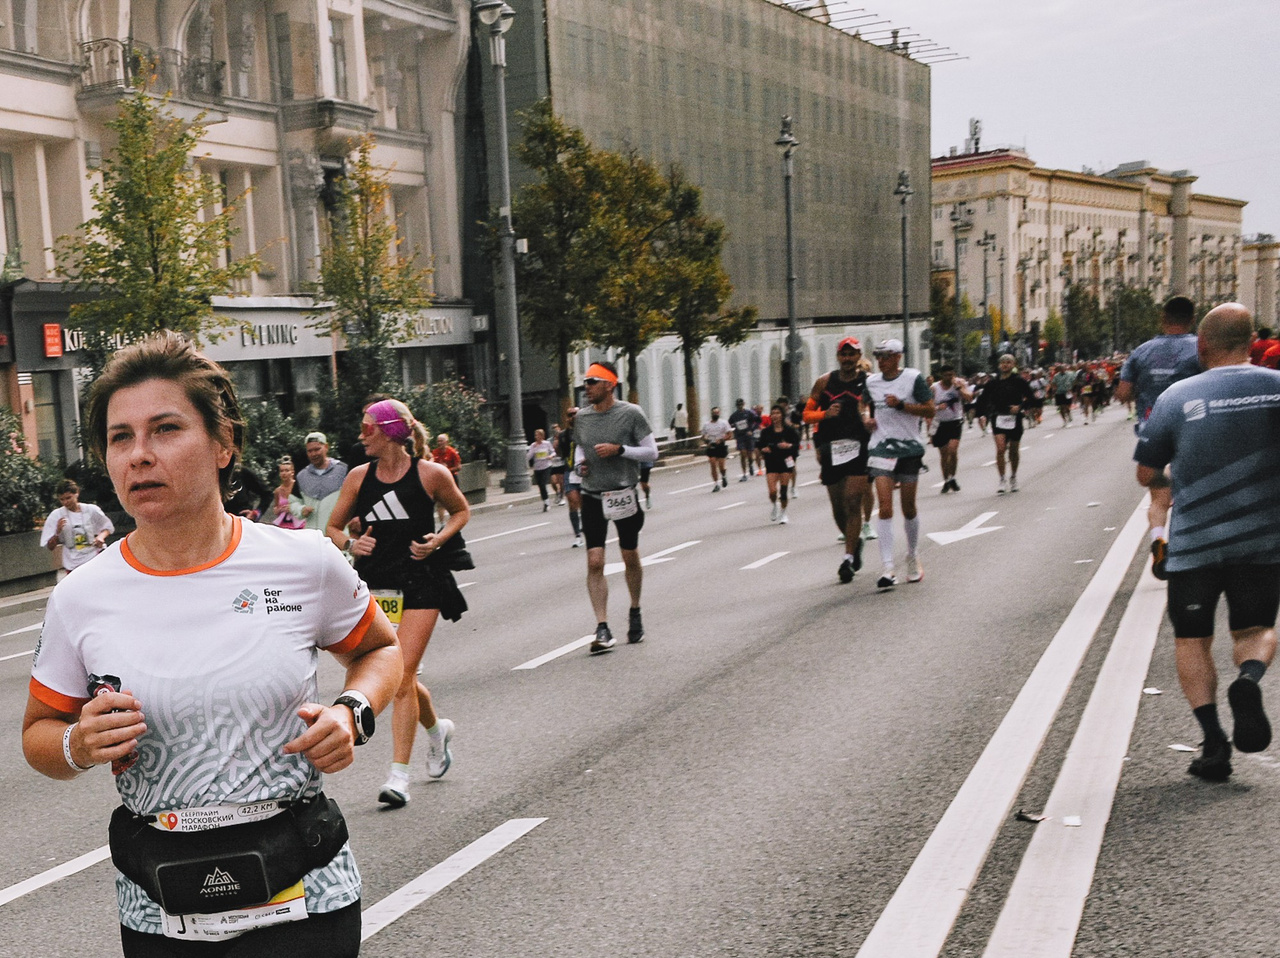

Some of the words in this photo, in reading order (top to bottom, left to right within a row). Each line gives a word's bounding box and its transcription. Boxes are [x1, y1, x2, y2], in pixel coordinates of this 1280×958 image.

[263, 588, 282, 597] бег
[266, 603, 303, 615] районе
[376, 600, 399, 613] 08
[180, 810, 219, 818] СБЕРПРАЙМ
[241, 805, 258, 815] 42,2
[181, 814, 234, 825] МОСКОВСКИЙ
